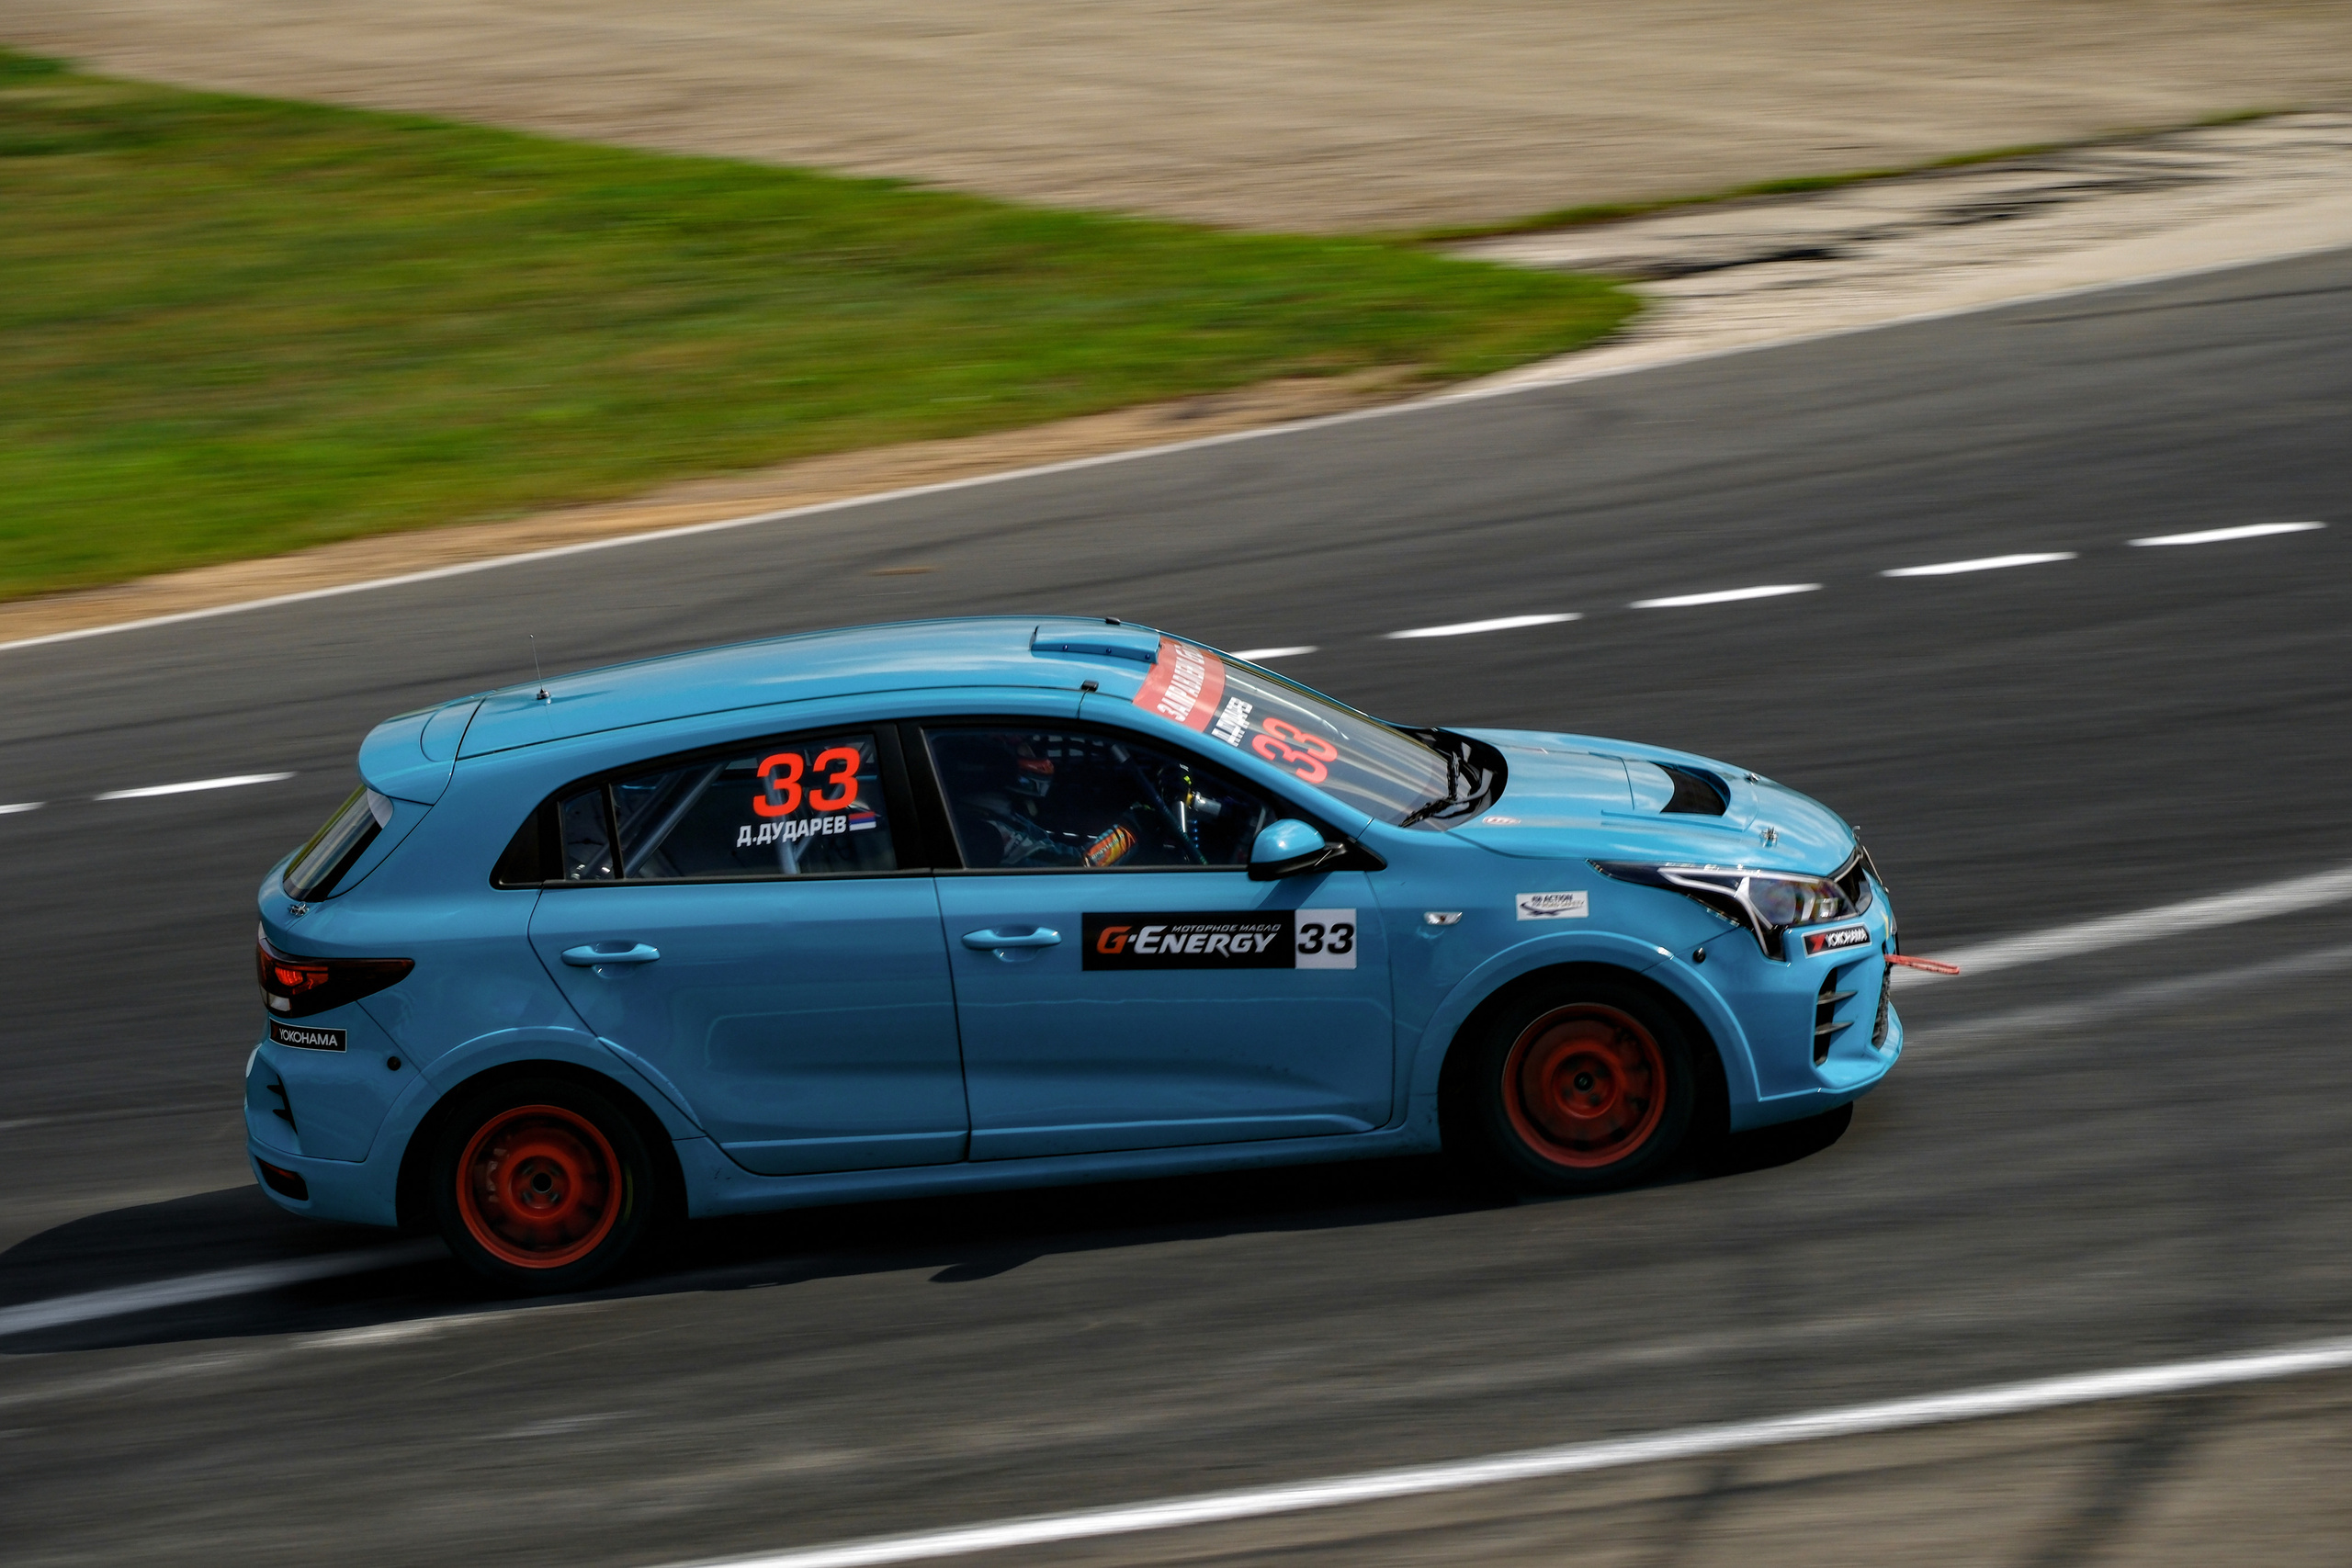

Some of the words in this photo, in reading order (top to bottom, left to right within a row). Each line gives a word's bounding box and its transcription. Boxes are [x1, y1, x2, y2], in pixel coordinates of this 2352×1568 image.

[1157, 656, 1205, 722] ЗАПРАВЛЕНО
[1251, 717, 1338, 784] 33
[752, 747, 860, 817] 33
[736, 815, 847, 848] Д.ДУДАРЕВ
[1297, 923, 1355, 954] 33
[1826, 928, 1868, 947] YOKOHAMA
[278, 1028, 338, 1046] YOKOHAMA
